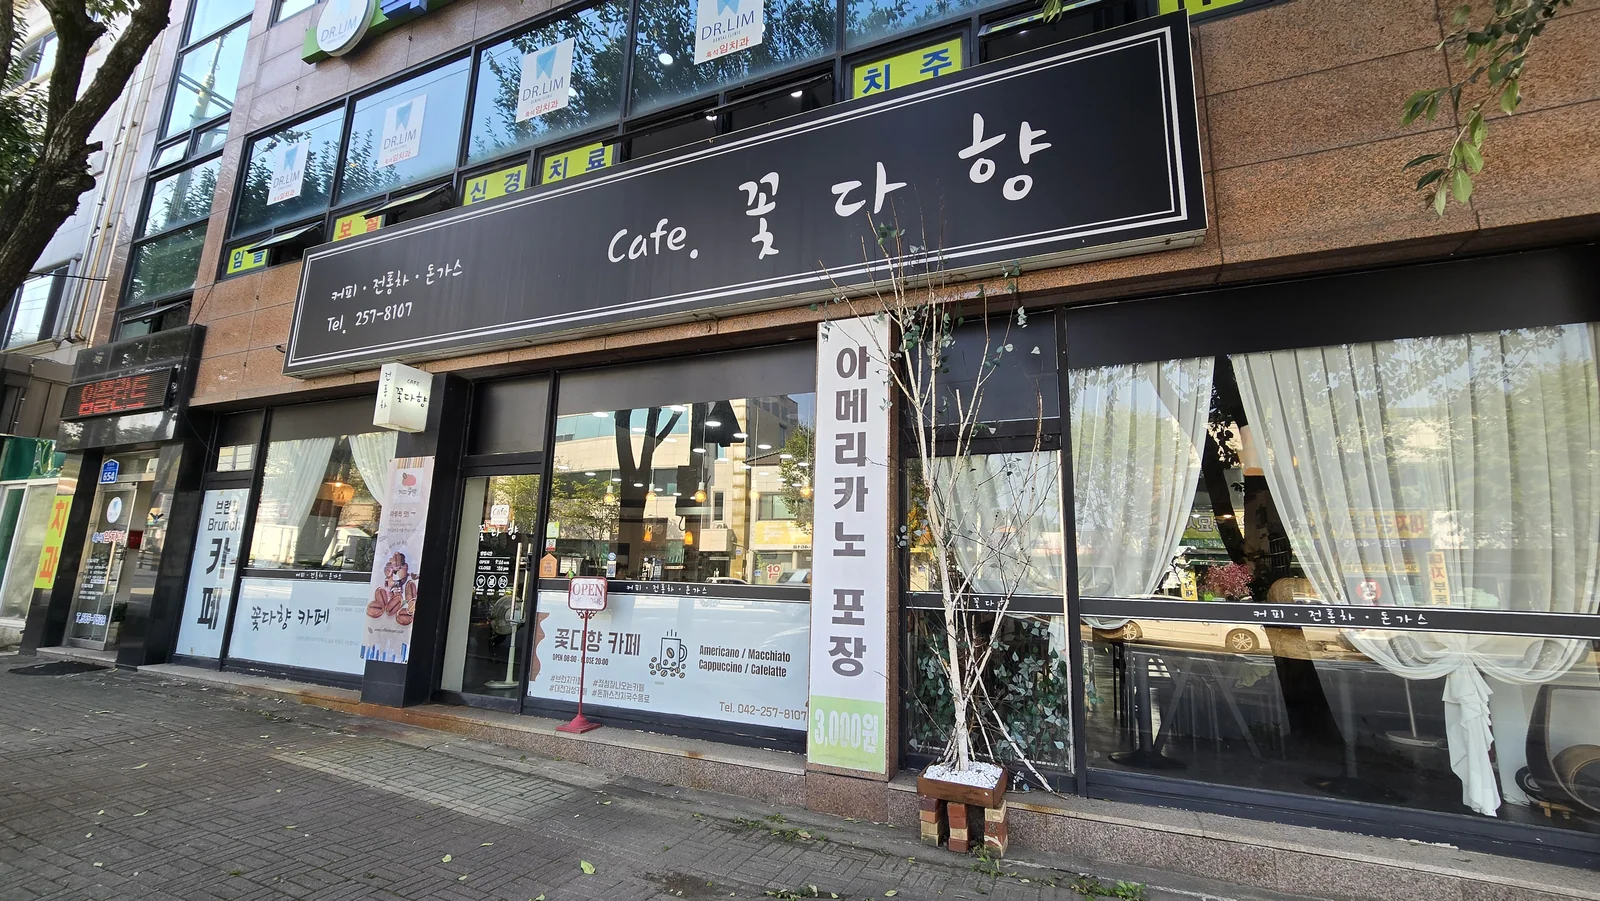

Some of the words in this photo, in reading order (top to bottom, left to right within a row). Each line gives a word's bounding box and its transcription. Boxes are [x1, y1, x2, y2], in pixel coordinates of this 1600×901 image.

[320, 16, 357, 42] DR.LIM
[701, 10, 754, 41] DR.LIM
[522, 76, 564, 102] DR.LIM
[383, 128, 417, 150] DR.LIM
[273, 170, 300, 189] DR.LIM
[469, 170, 523, 203] 신경
[548, 145, 608, 181] 치료
[331, 284, 357, 301] 커피
[372, 270, 410, 295] 전통차
[426, 258, 463, 286] 돈가스
[327, 314, 346, 335] Tel.
[355, 302, 413, 327] 257-8107
[78, 375, 151, 416] 임플란트
[395, 386, 428, 408] 꽃다향
[833, 345, 870, 557] 아메리카노
[102, 471, 116, 482] 654
[207, 518, 240, 532] Brunch
[39, 499, 71, 586] 치과
[197, 537, 231, 630] 카페
[572, 582, 603, 597] OPEN
[626, 584, 642, 592] 커피
[652, 584, 674, 594] 전통차
[685, 586, 708, 595] 돈가스
[250, 603, 292, 632] 꽃다향
[297, 608, 330, 626] 카페
[1253, 609, 1285, 619] 커피
[1308, 608, 1356, 624] 전통차
[1380, 612, 1429, 626] 돈가스
[608, 632, 641, 656] 카페
[828, 588, 867, 677] 포장
[552, 653, 563, 661] OPEN
[563, 654, 577, 663] 08:00
[595, 657, 609, 666] 20:00
[699, 645, 740, 659] Americano
[748, 648, 791, 663] Macchiato
[698, 659, 743, 674] Cappuccino
[751, 664, 787, 678] Cafelatte
[719, 701, 735, 713] Tel.
[737, 703, 807, 721] 042-257-8107
[814, 708, 879, 754] 3,000원
